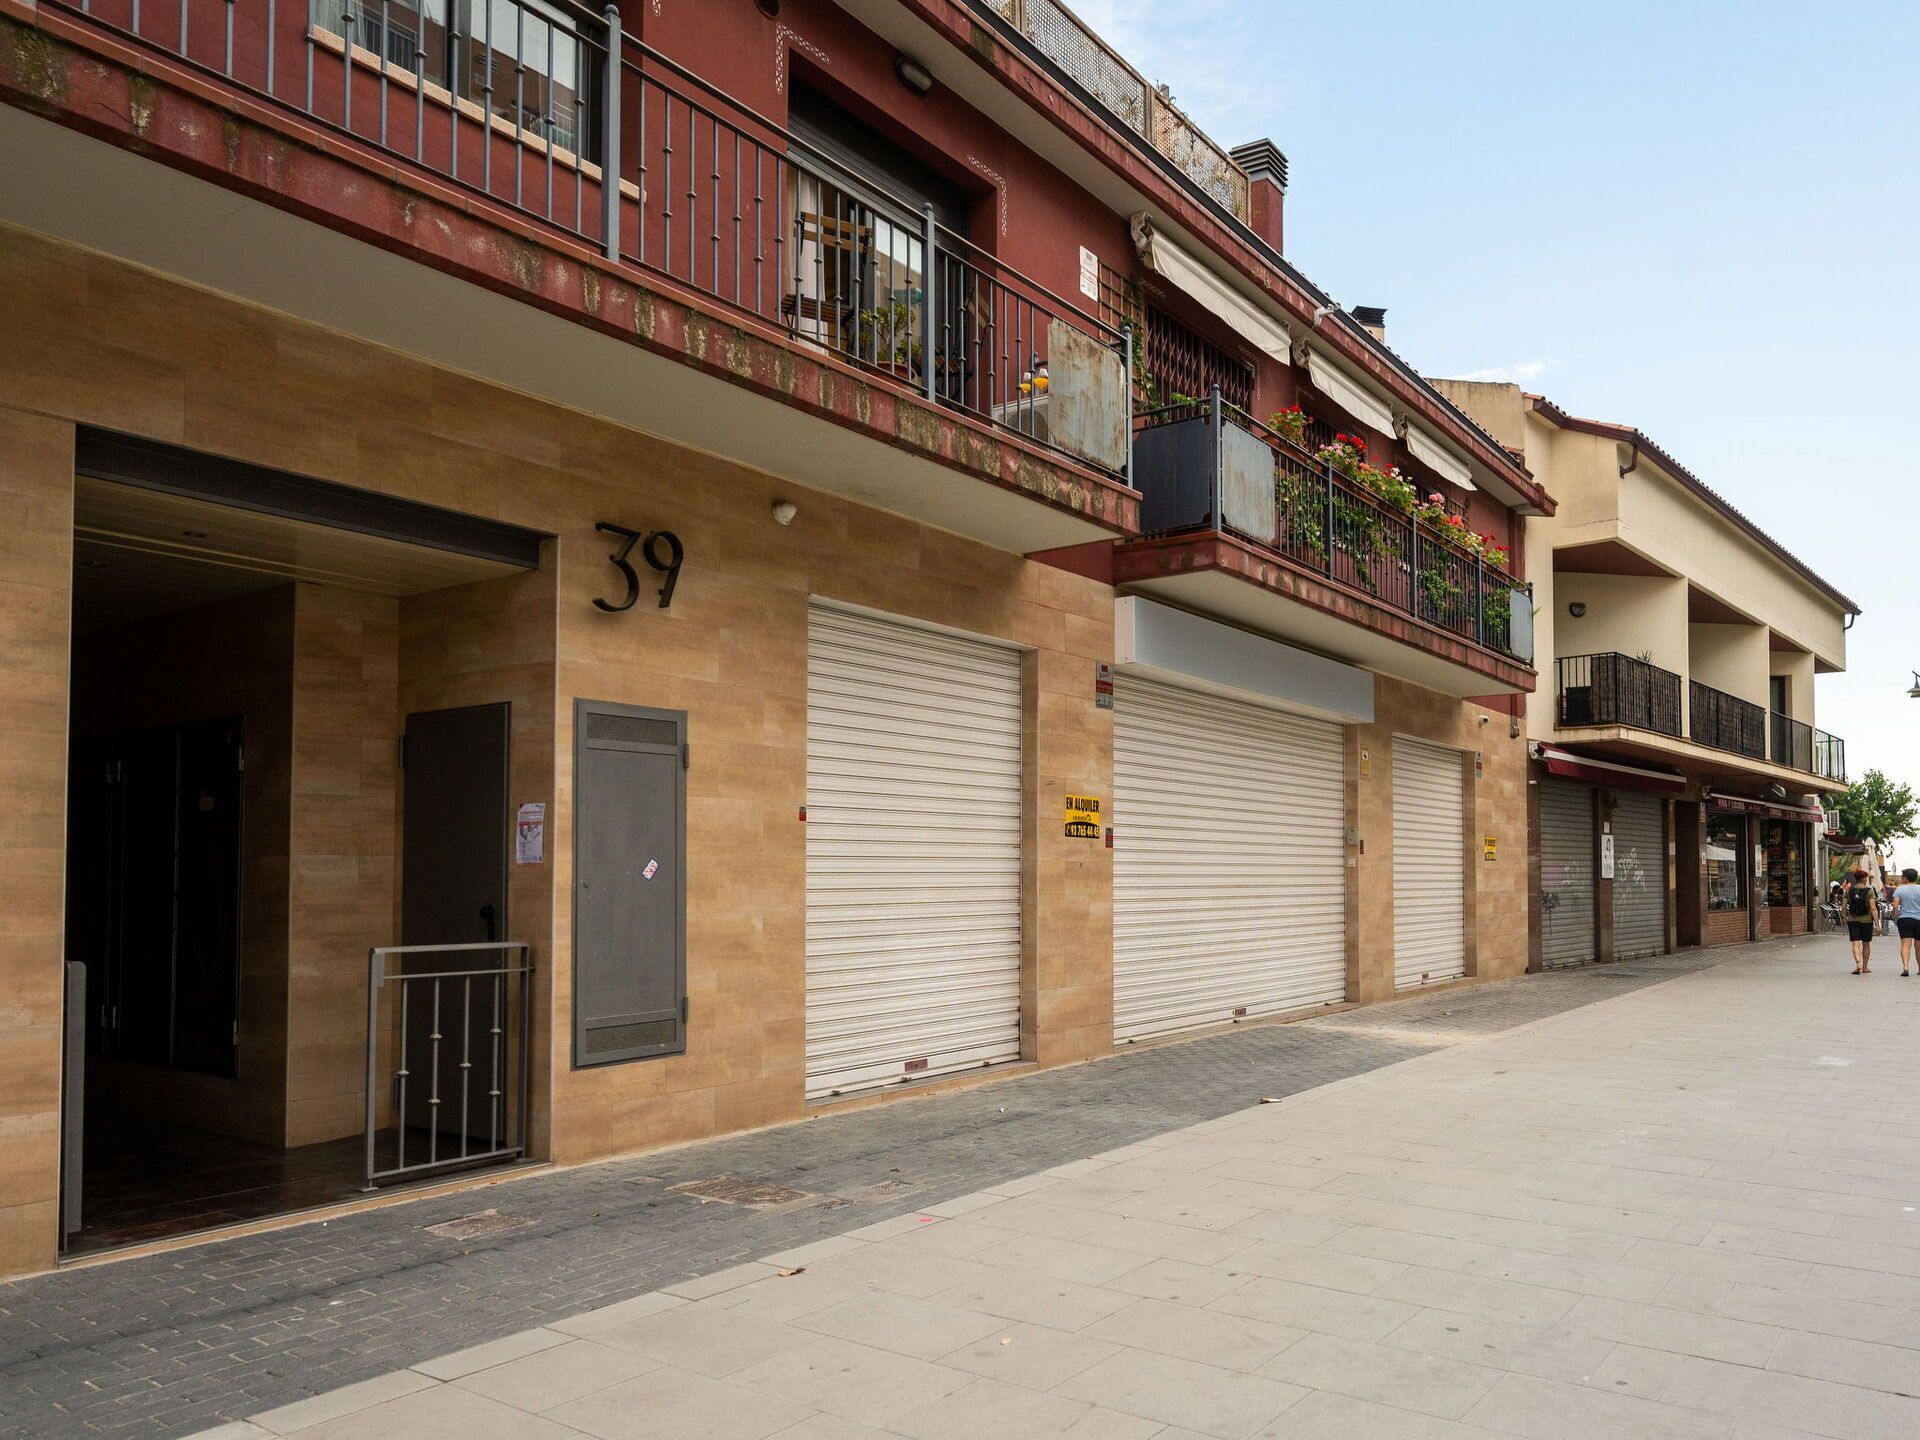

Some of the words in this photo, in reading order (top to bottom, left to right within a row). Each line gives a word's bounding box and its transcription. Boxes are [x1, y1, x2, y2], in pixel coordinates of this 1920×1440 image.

[592, 522, 684, 613] 39
[1066, 797, 1073, 810] EN
[1075, 798, 1100, 813] ALQUILER
